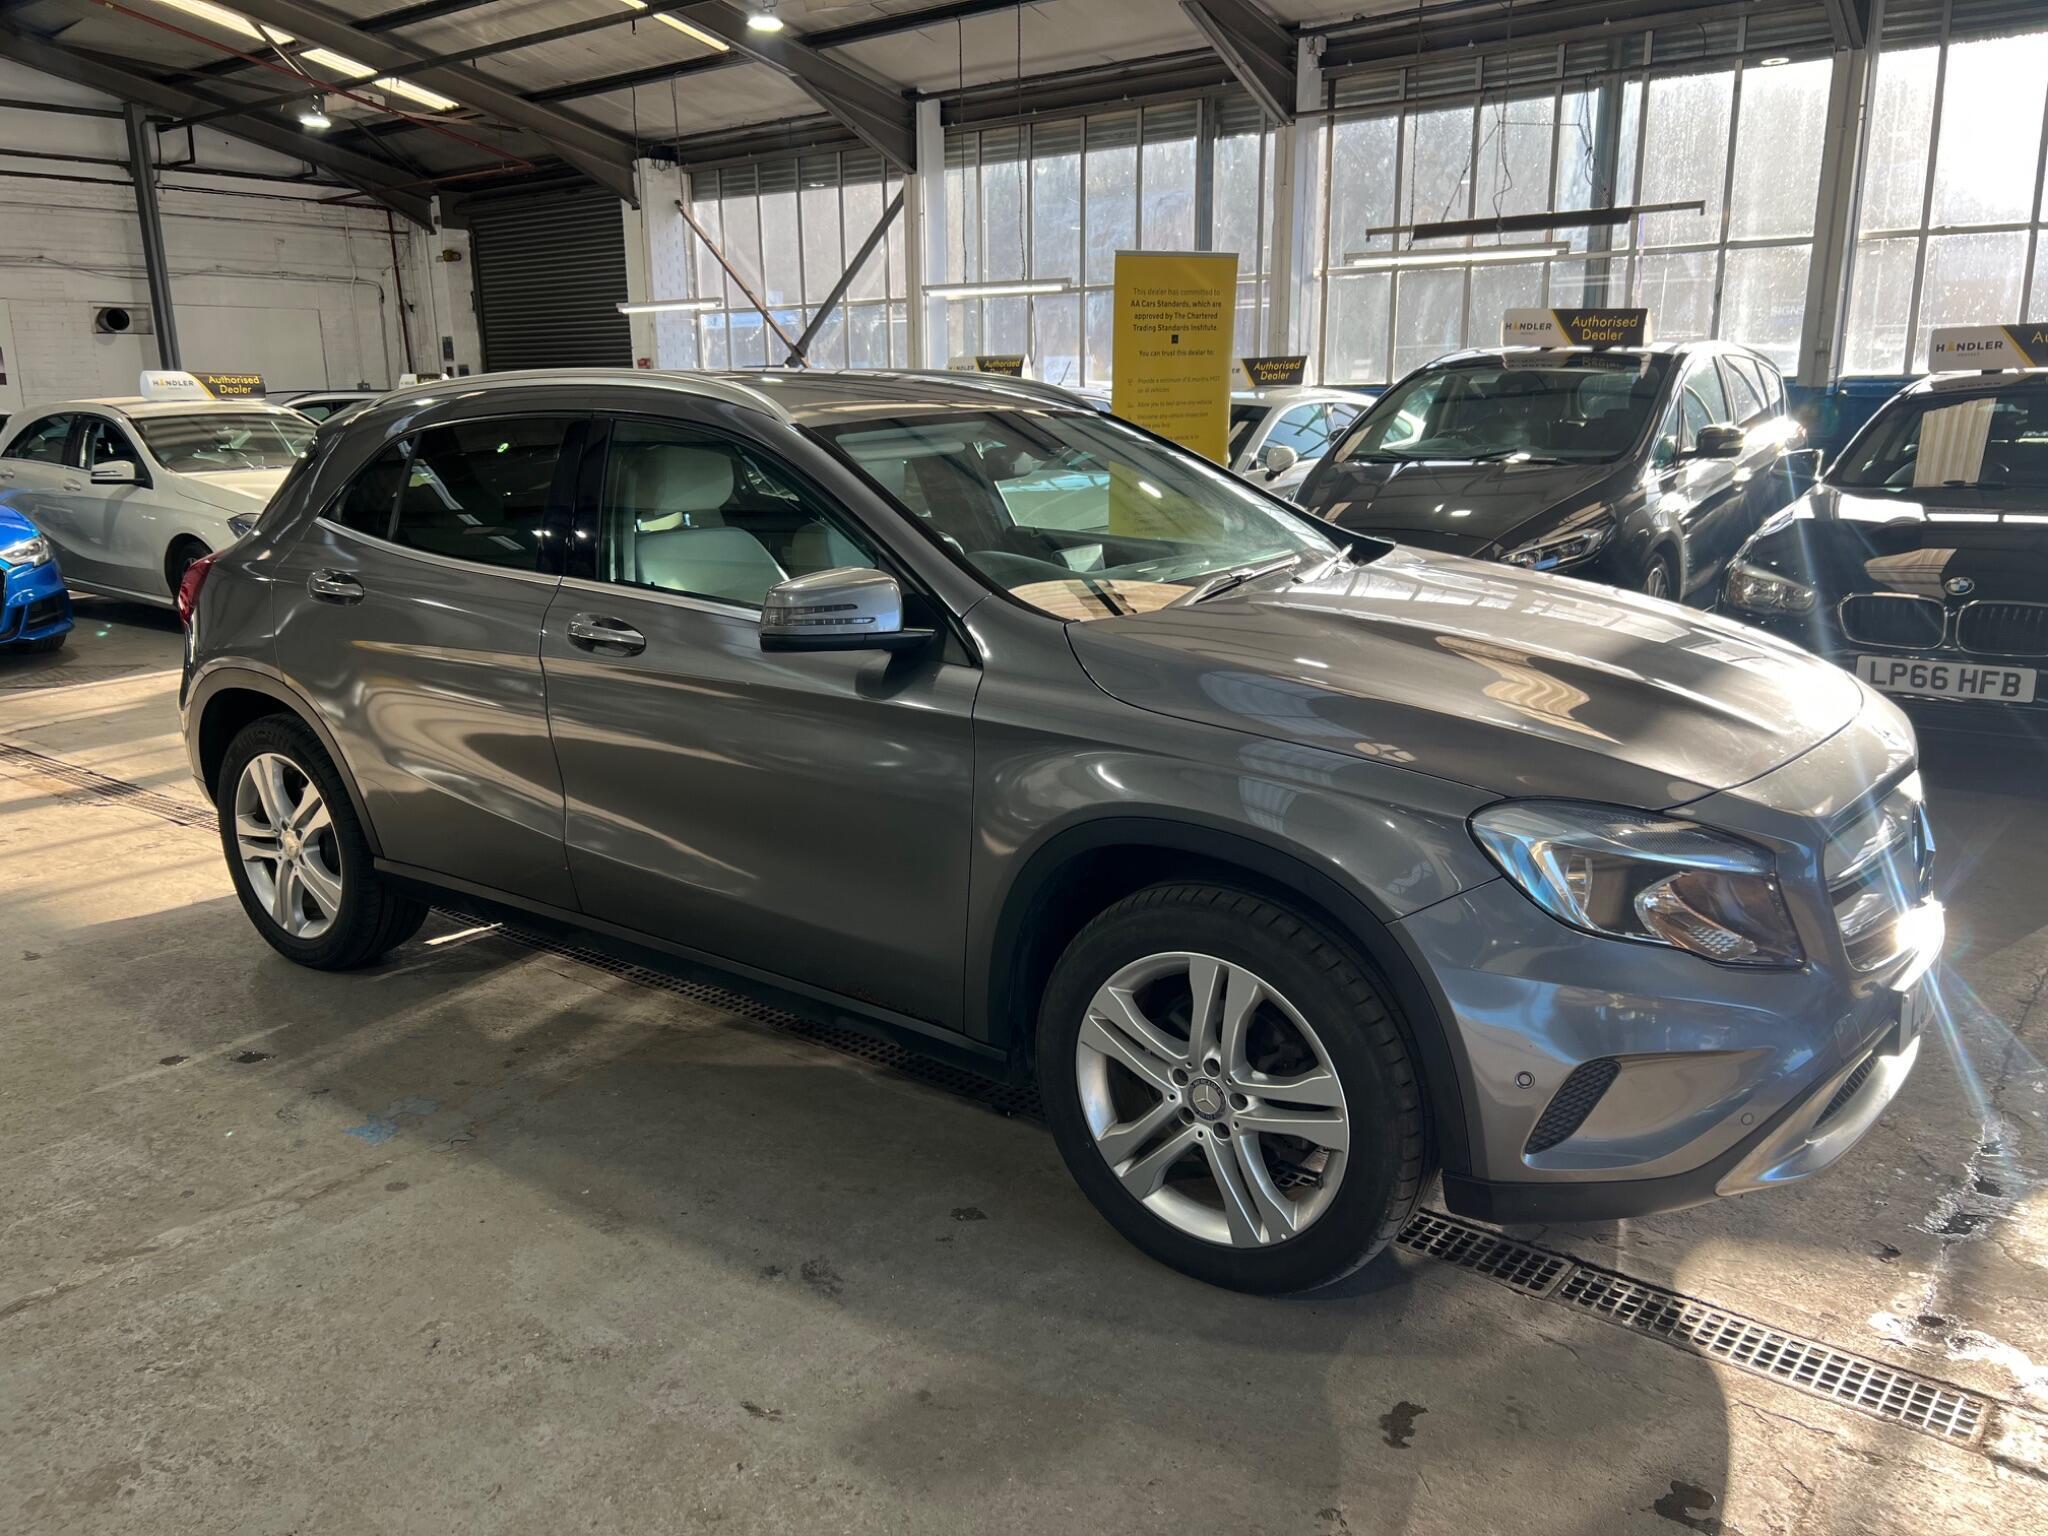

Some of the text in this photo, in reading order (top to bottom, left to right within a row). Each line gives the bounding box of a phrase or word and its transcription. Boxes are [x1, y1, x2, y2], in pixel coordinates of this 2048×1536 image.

[1148, 288, 1167, 296] dealer
[1157, 300, 1191, 308] Standards,
[1134, 313, 1164, 321] approved
[1165, 312, 1173, 321] by
[1174, 311, 1185, 319] The
[1505, 321, 1552, 331] HANDLER
[1571, 316, 1639, 328] Authorised
[1133, 324, 1156, 333] Trading
[1582, 329, 1623, 341] Dealer
[1935, 340, 2004, 352] HANDLER
[1254, 360, 1301, 371] Authorised
[208, 376, 260, 385] Authorised
[1260, 371, 1290, 380] Dealer
[219, 385, 252, 394] Dealer
[1869, 661, 2021, 697] LP66 HFB
